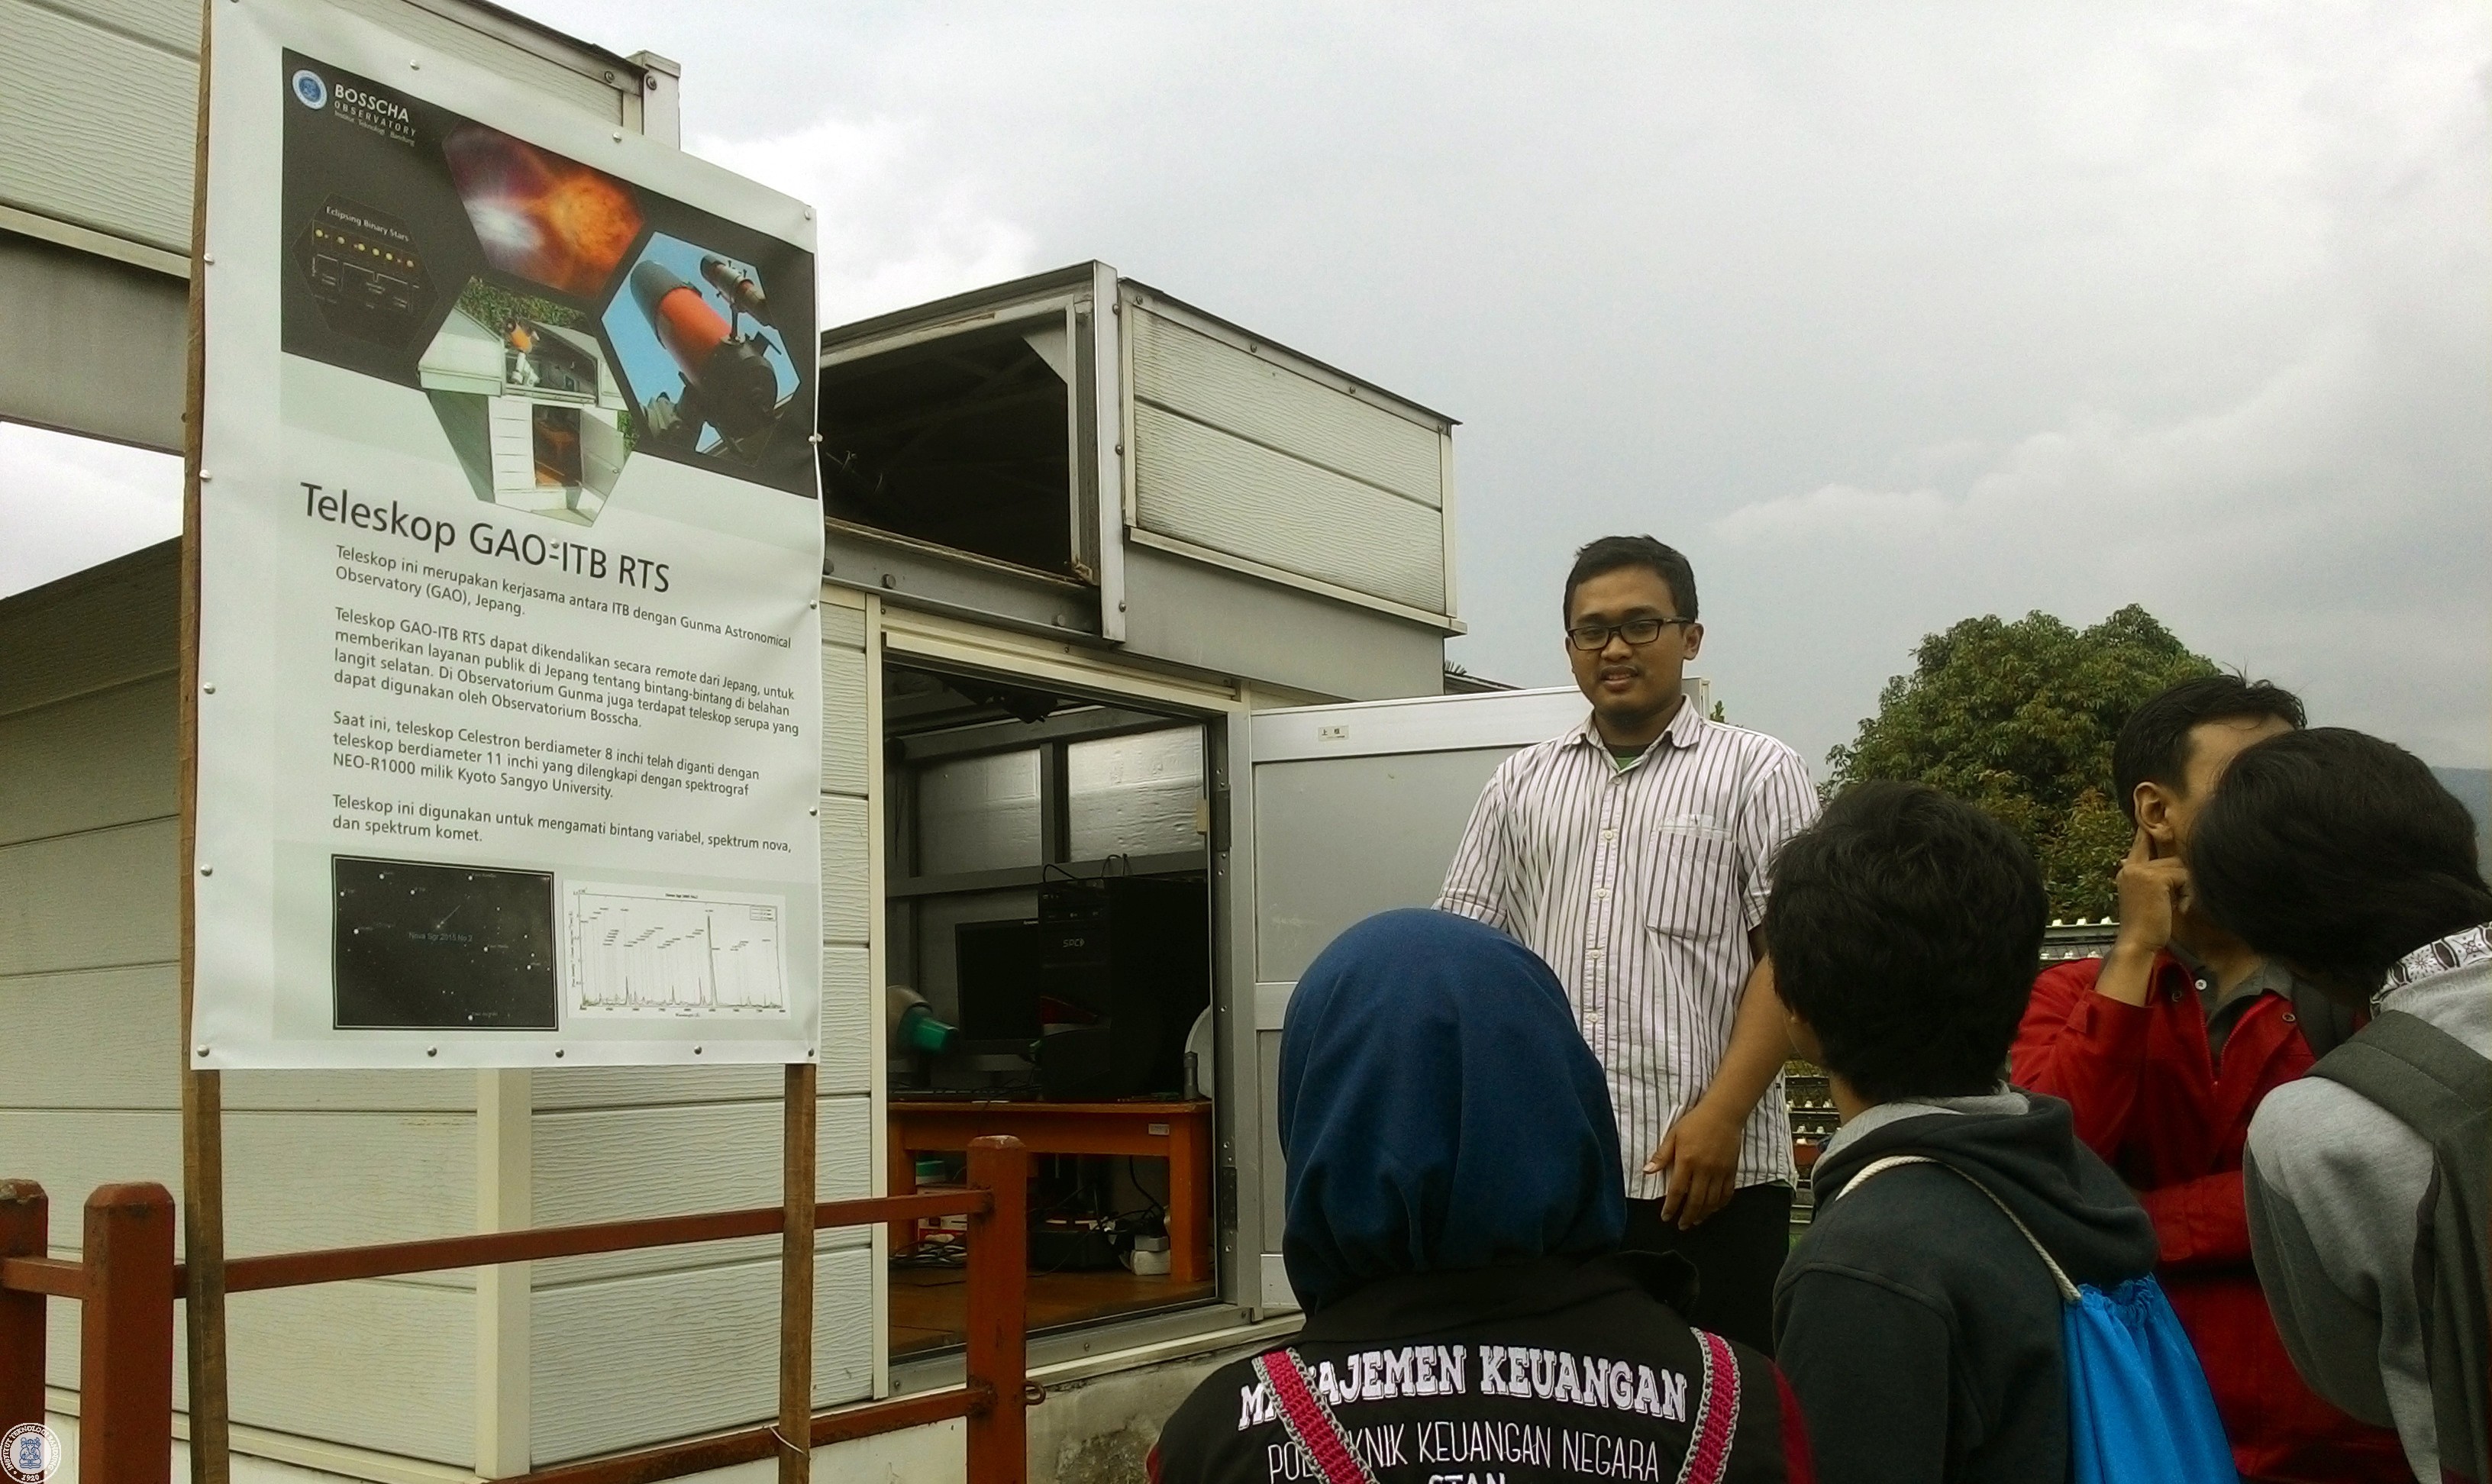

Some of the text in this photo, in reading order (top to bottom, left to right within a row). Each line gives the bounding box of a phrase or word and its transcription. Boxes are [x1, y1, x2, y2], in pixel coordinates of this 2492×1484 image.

[334, 83, 410, 123] BOSSCHA
[334, 100, 416, 137] OBSERVATORY
[326, 205, 409, 242] Eclipsing Binary Stars
[300, 481, 670, 594] Teleskop GAO-ITB RTS
[335, 566, 525, 618] Observatory (GAO), Jepang.
[335, 544, 791, 649] Teleskop ini merupakan kerjasama antara ITB dengan Gunma Astronomical
[334, 606, 795, 700] Teleskop GAO-ITB RTS dapat dikendalikan secara remote dari Jepang, untuk
[334, 631, 790, 717] memberikan layanan publik di Jepang tentang bintang-bintang di belahan
[334, 647, 799, 737] langit selatan. Di Observatorium Gunma juga terdapat teleskop serupa yang
[334, 668, 642, 727] dapat digunakan oleh Observatorium Bosscha.
[332, 732, 750, 798] teleskop berdiameter 11 inchi yang dilengkapi dengan spektrograf
[333, 710, 760, 782] Saat ini, teleskop Celestron berdiameter 8 inchi telah diganti dengan
[333, 752, 613, 801] NEO-R1000 milik Kyoto Sangyo University.
[331, 793, 792, 853] Teleskop ini digunakan untuk mengamati bintang variabel, spektrum nova,
[332, 814, 483, 842] dan spektrum komet.
[1238, 1344, 1687, 1431] MAJEMEN KEUANGAN
[1417, 1421, 1551, 1469] KEUANGAN
[1563, 1428, 1659, 1483] NEGARA
